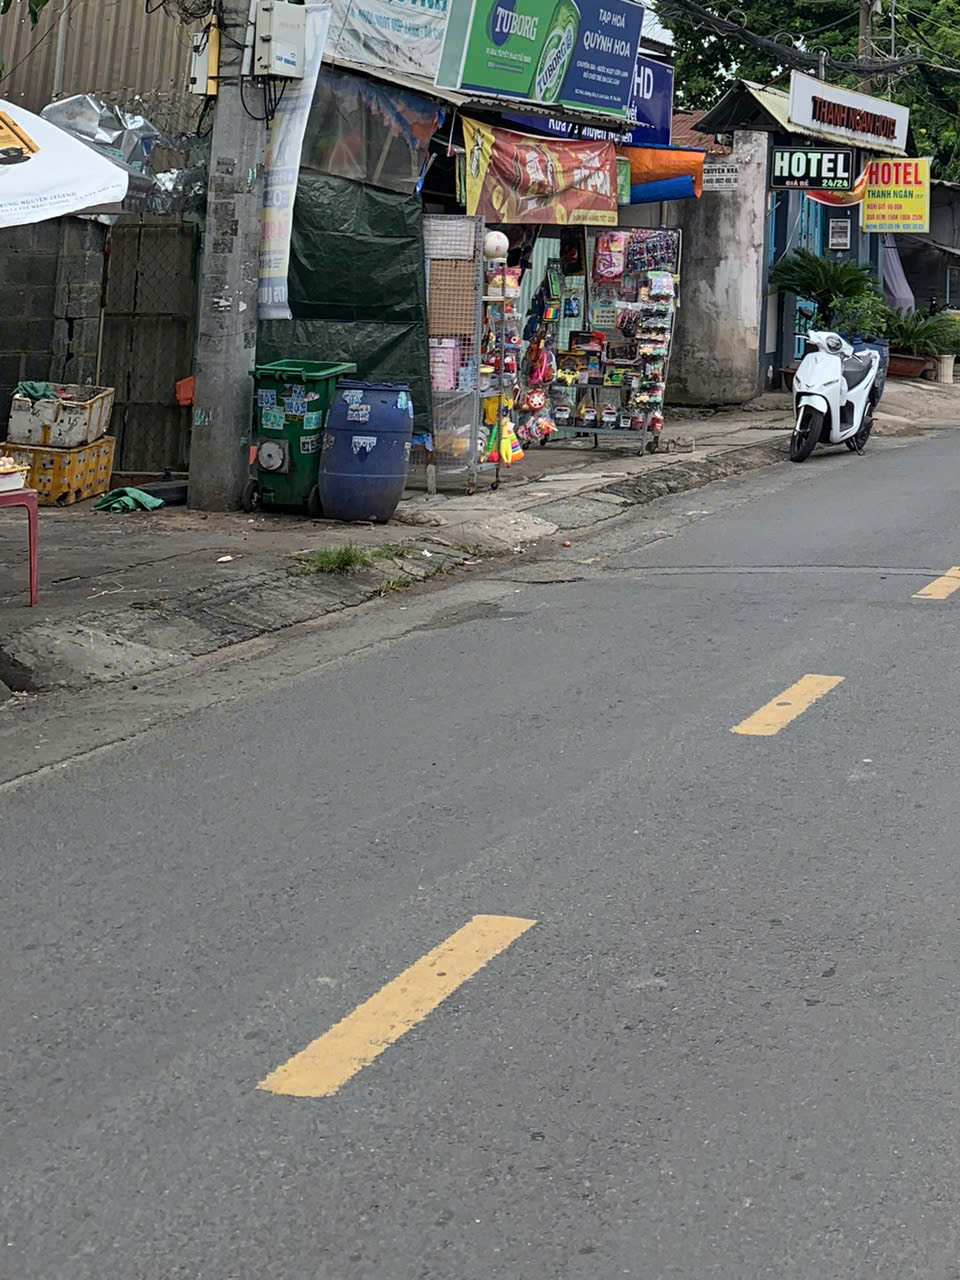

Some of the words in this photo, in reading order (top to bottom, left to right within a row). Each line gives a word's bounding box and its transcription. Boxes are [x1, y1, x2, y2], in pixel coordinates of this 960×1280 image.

[495, 6, 539, 41] TUBORG
[599, 8, 612, 25] TẠP
[583, 29, 613, 54] QUỲNH
[613, 37, 631, 58] HOA
[537, 39, 568, 94] TUBORG
[811, 95, 848, 129] THANH
[873, 114, 897, 140] HOTEL
[774, 151, 849, 178] HOTEL
[868, 162, 922, 185] HOTEL
[821, 179, 849, 188] 24/24
[867, 189, 892, 199] THANH
